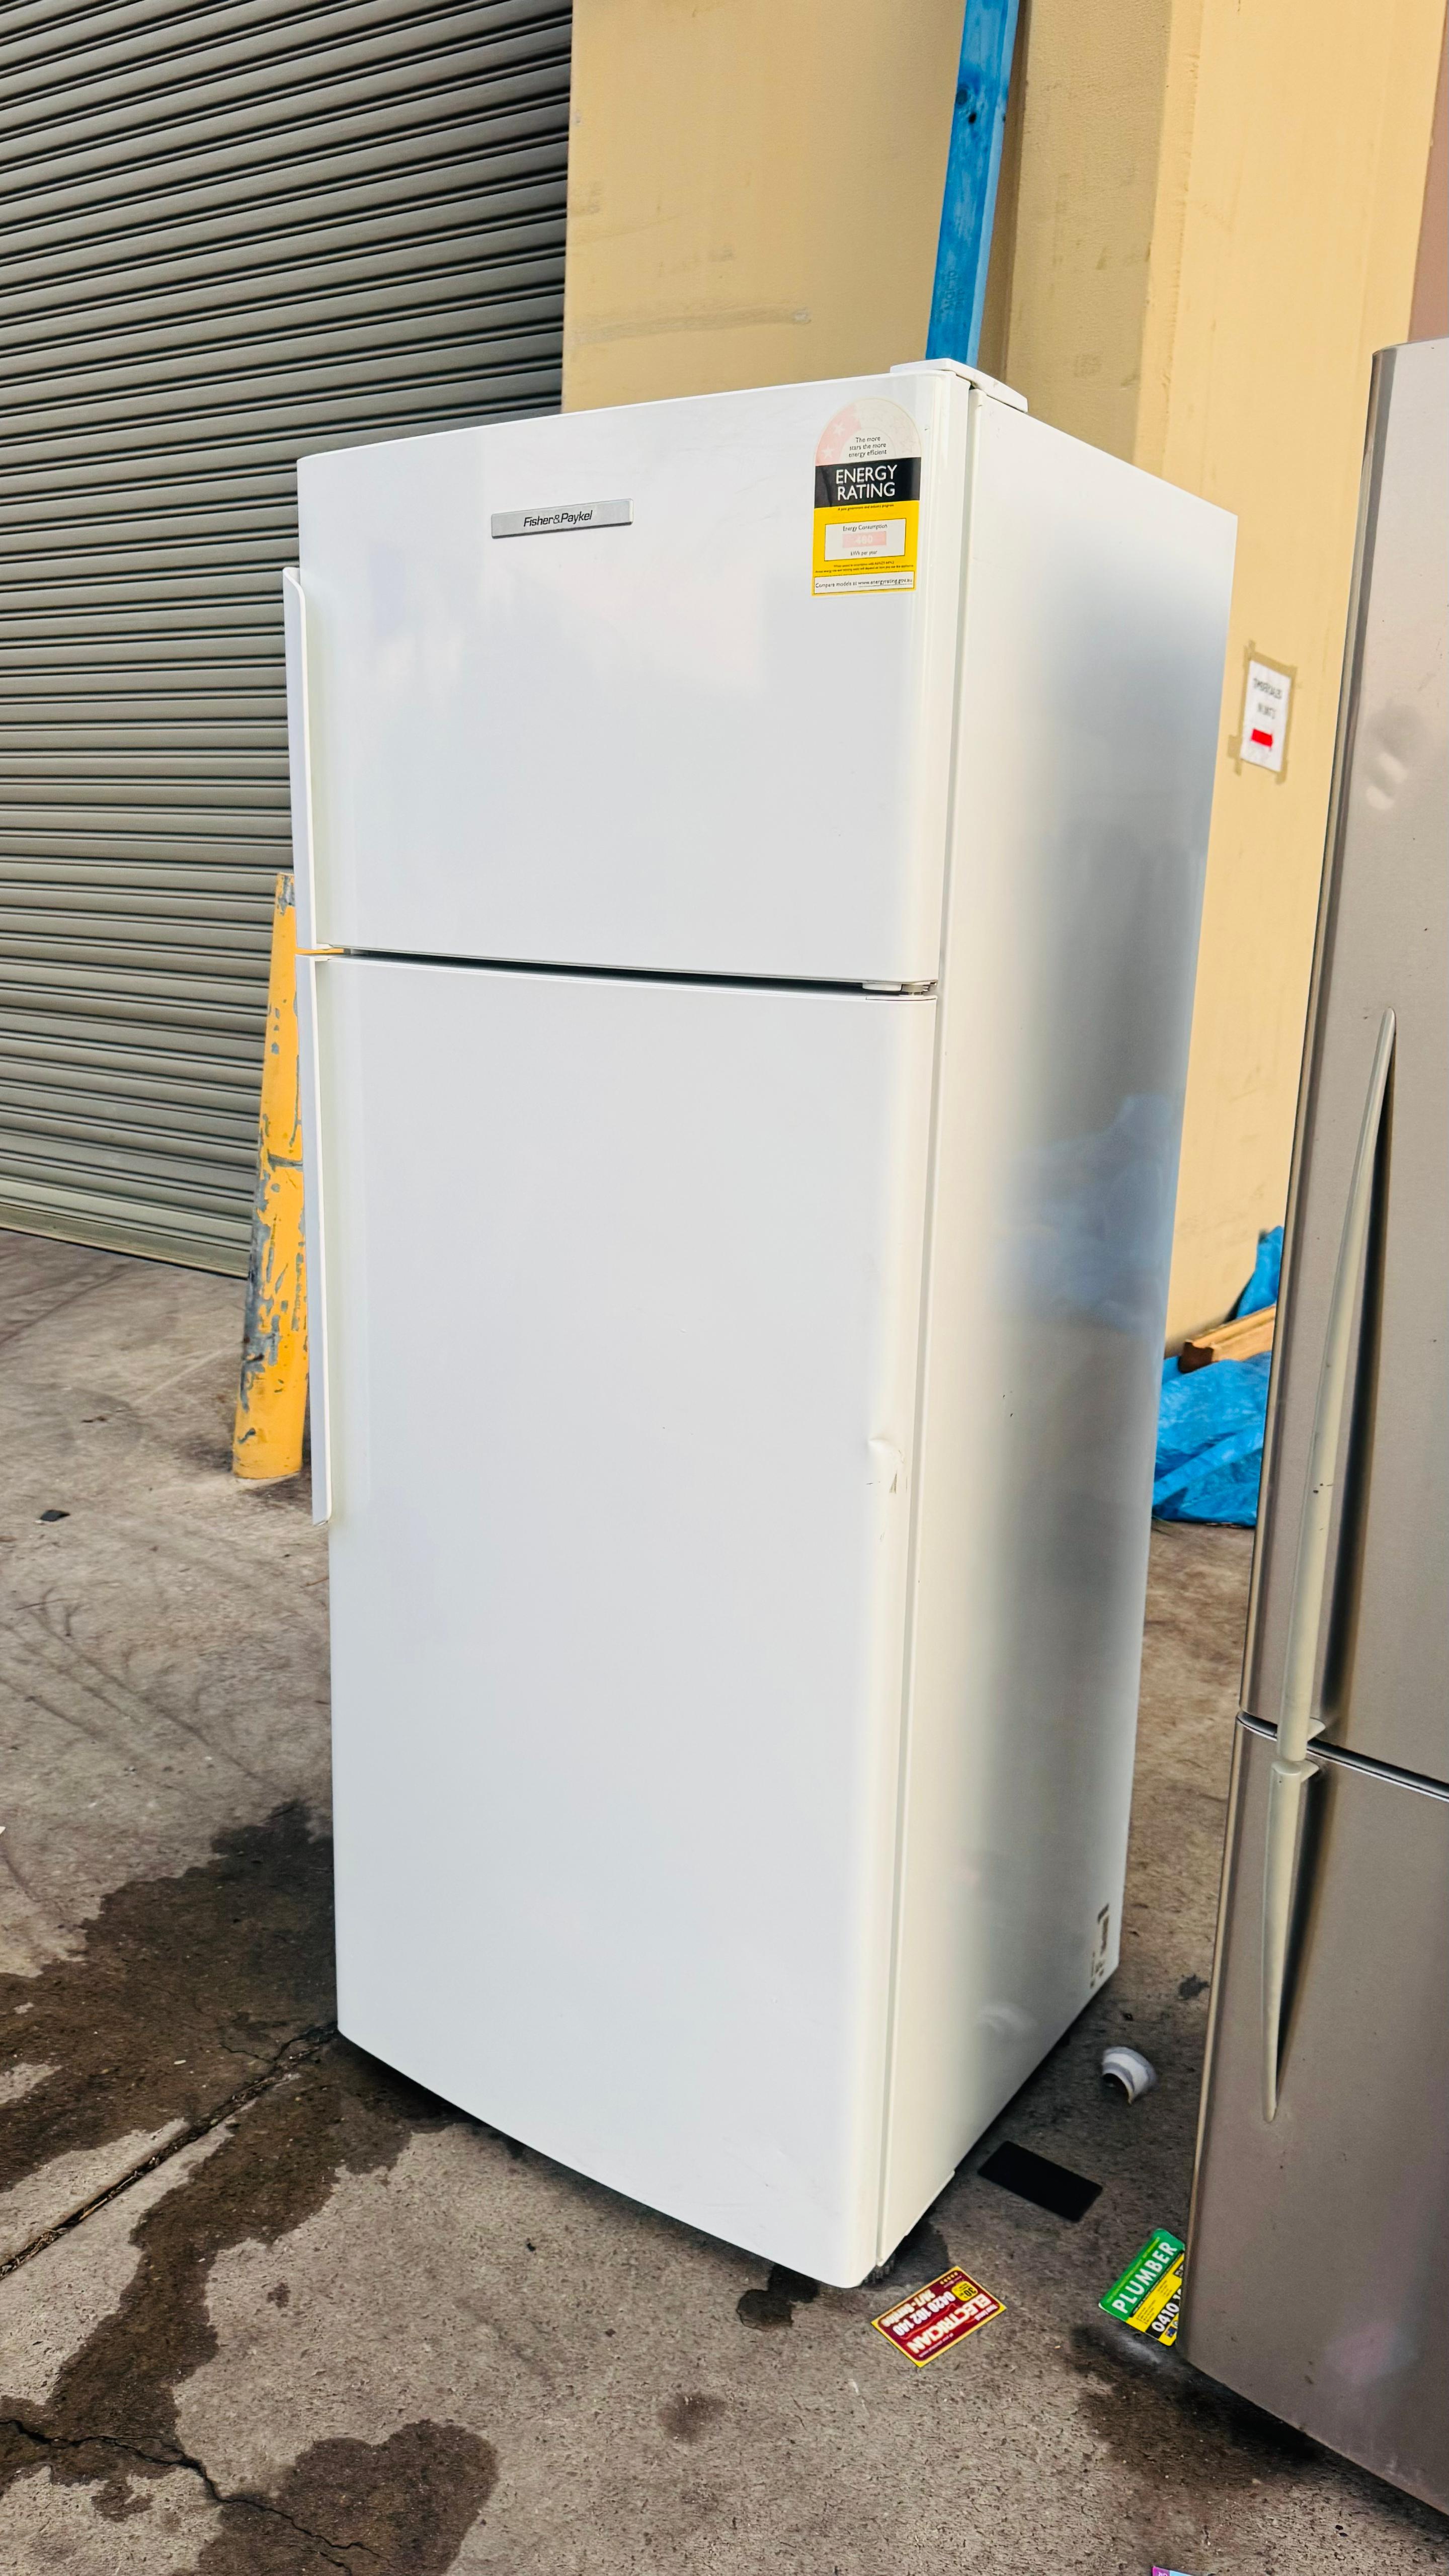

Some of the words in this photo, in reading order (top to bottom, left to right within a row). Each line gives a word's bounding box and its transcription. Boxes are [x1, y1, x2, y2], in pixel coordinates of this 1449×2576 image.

[836, 464, 898, 484] ENERGY
[838, 482, 895, 501] RATING
[523, 510, 593, 527] Fisher&Paykel
[1112, 2242, 1178, 2314] PLUMBER
[963, 2287, 977, 2297] 30
[927, 2291, 956, 2313] 0420
[906, 2293, 992, 2354] ELECTRICIAN
[909, 2307, 932, 2324] 102
[1152, 2303, 1179, 2332] 0410
[893, 2321, 914, 2337] 140
